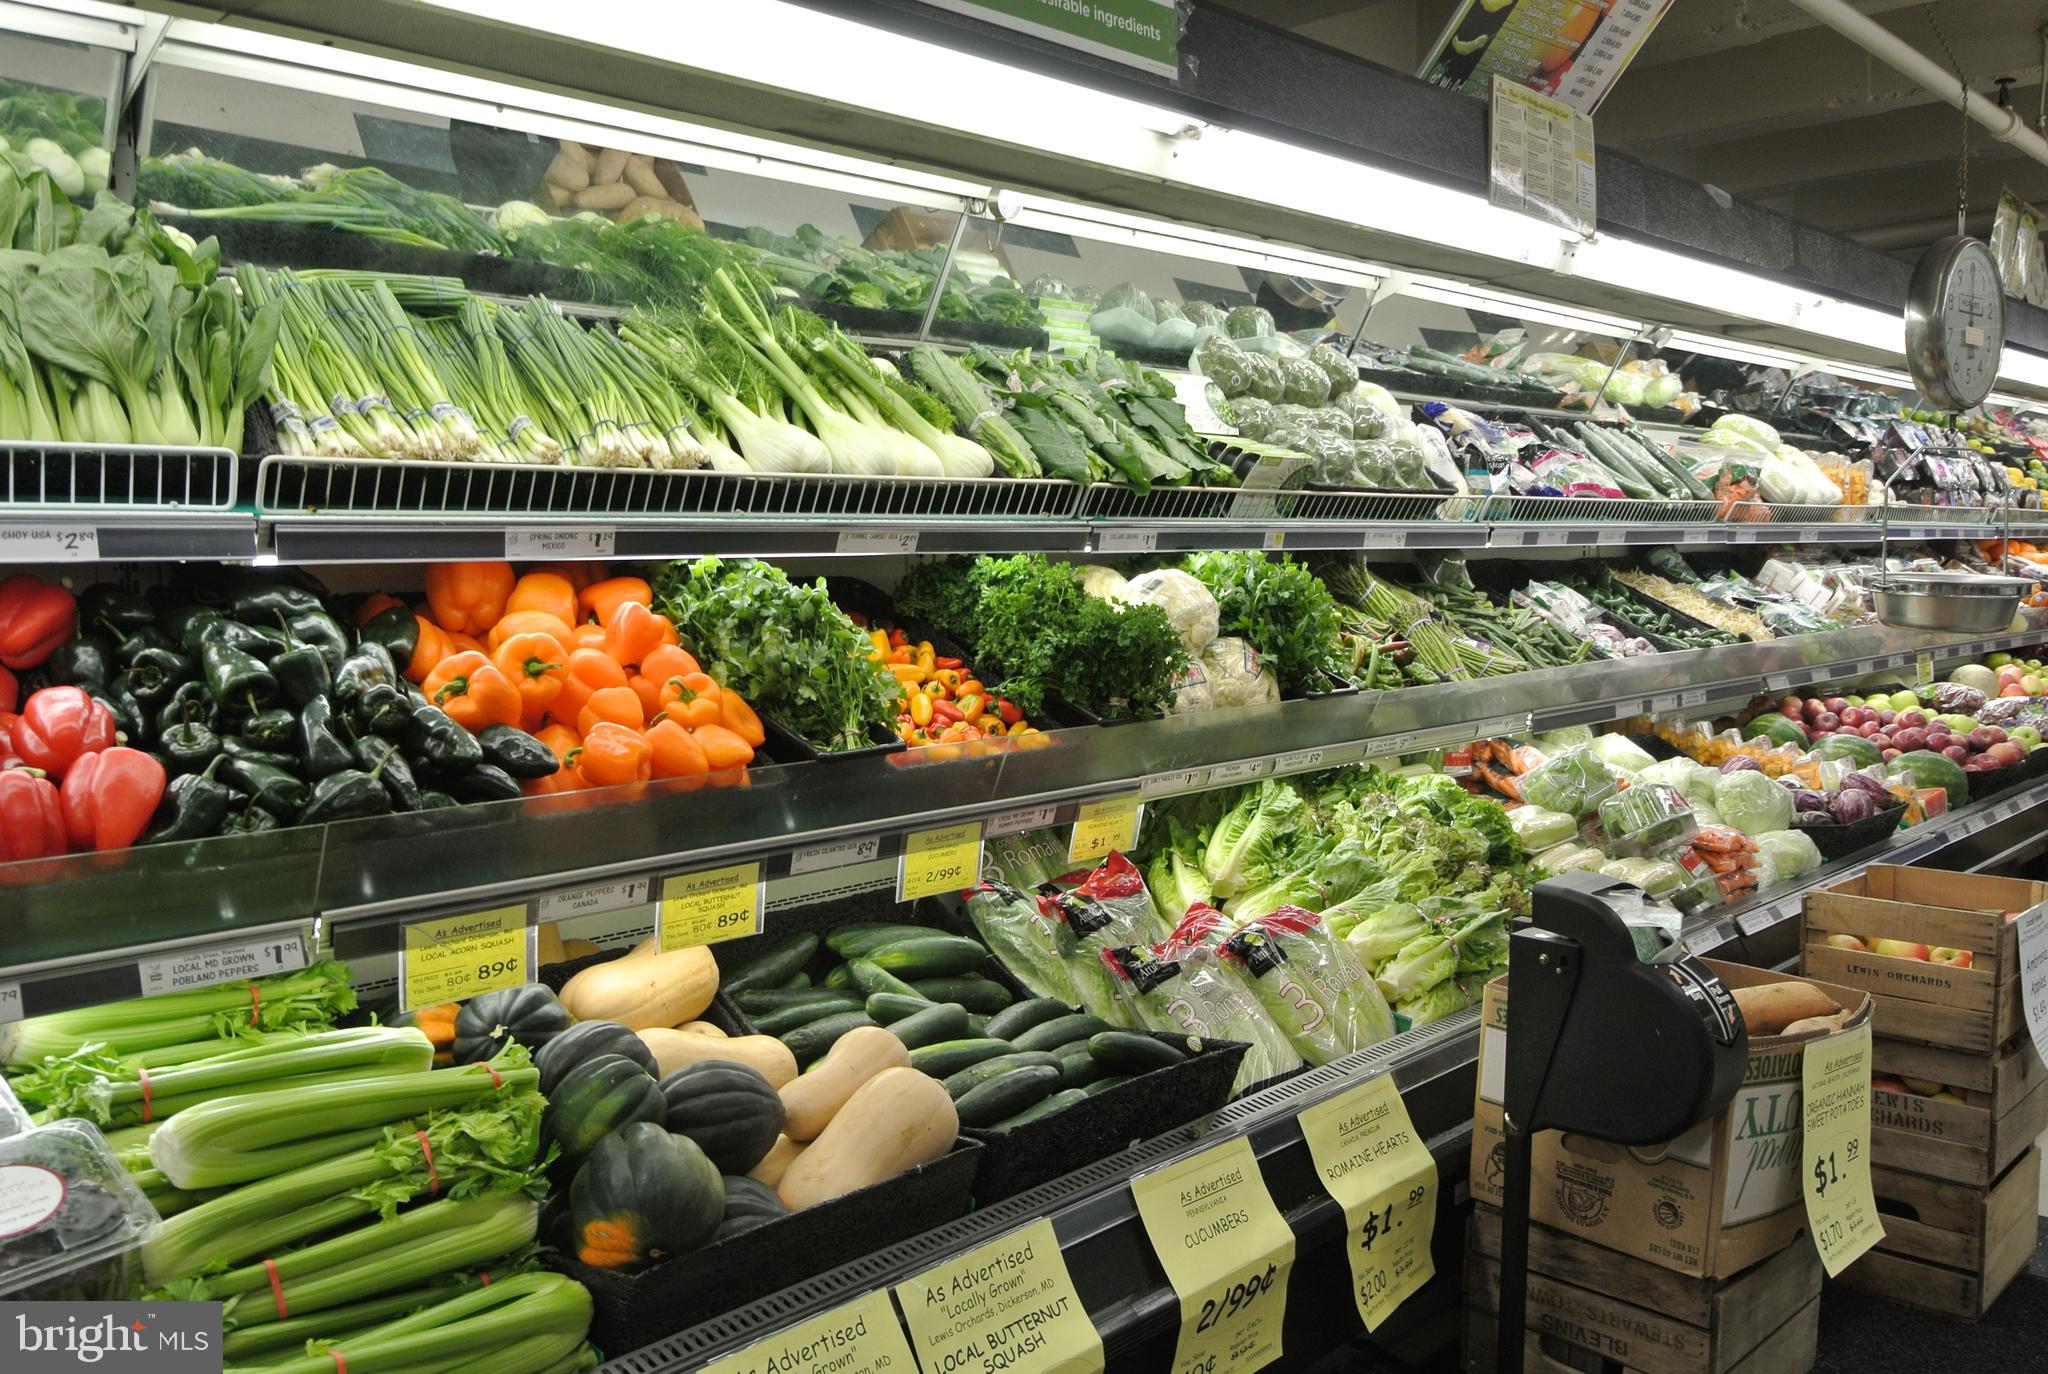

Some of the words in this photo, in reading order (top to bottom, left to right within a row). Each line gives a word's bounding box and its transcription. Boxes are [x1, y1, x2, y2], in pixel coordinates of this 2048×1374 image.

[1094, 4, 1161, 41] ingredients
[1957, 269, 1963, 286] 9
[1970, 262, 1976, 279] 0
[1982, 276, 1986, 291] 1
[1987, 304, 1993, 320] 2
[1947, 327, 1953, 344] 7
[1986, 336, 1992, 353] 3
[1954, 355, 1960, 373] 6
[1977, 360, 1983, 376] 4
[1966, 368, 1971, 384] 5
[2, 531, 28, 540] CHOY
[32, 531, 52, 540] USA
[542, 542, 566, 550] MEXICO
[699, 873, 740, 887] Advertised
[926, 866, 962, 883] 2/99¢
[572, 899, 598, 909] CANADA
[681, 902, 701, 910] LOCAL
[704, 892, 741, 905] BUTTERNUT
[697, 902, 726, 913] SQUASH
[435, 929, 446, 938] As
[452, 918, 502, 934] Advertised
[717, 909, 749, 928] 89¢
[420, 951, 447, 962] LOCAL
[450, 945, 478, 956] ACORN
[480, 937, 515, 950] SQUASH
[172, 962, 202, 975] LOCAL
[205, 959, 219, 969] MD
[222, 953, 255, 966] GROWN
[172, 971, 216, 987] POBLANO
[219, 964, 259, 979] PEPPERS
[478, 957, 518, 980] 89¢
[446, 973, 472, 987] 80¢
[1887, 971, 1952, 989] ORCHARDS
[1167, 998, 1211, 1038] 3
[1279, 981, 1326, 1032] 3
[1824, 1061, 1833, 1072] As
[1834, 1049, 1864, 1068] Advertised
[1806, 1092, 1836, 1117] ORGANIC
[1836, 1079, 1865, 1102] HANNAH
[1872, 1090, 1925, 1113] EWIS
[1339, 1122, 1348, 1133] As
[1350, 1101, 1389, 1128] Advertised
[1806, 1110, 1829, 1133] SWEET
[1829, 1095, 1865, 1121] POTATOES
[1326, 1148, 1374, 1181] ROMAINE
[1372, 1131, 1409, 1158] HEARTS
[1847, 1138, 1859, 1159] 99
[1180, 1191, 1192, 1204] As
[1194, 1167, 1242, 1198] Advertised
[1185, 1195, 1227, 1218] PENNSYLVANIA
[1184, 1209, 1249, 1249] CUCUMBERS
[1684, 1256, 1698, 1267] NET
[926, 1285, 946, 1307] As
[952, 1241, 1034, 1295] Advertised
[940, 1292, 986, 1319] "Locally
[989, 1269, 1026, 1298] Grown"
[1196, 1263, 1277, 1334] 2/99¢
[1360, 1269, 1386, 1307] $2.00
[928, 1327, 954, 1347] Lewis
[955, 1307, 999, 1334] Orchards,
[997, 1287, 1041, 1313] Dickerson,
[1040, 1278, 1055, 1292] MD
[934, 1342, 985, 1374] LOCAL
[986, 1296, 1070, 1350] BUTTERNUT
[1541, 1313, 1628, 1357] BLEVINS
[1585, 1306, 1686, 1351] STEWARTS
[767, 1315, 867, 1374] Advertised
[983, 1331, 1047, 1374] SQUASH
[875, 1355, 891, 1371] MD
